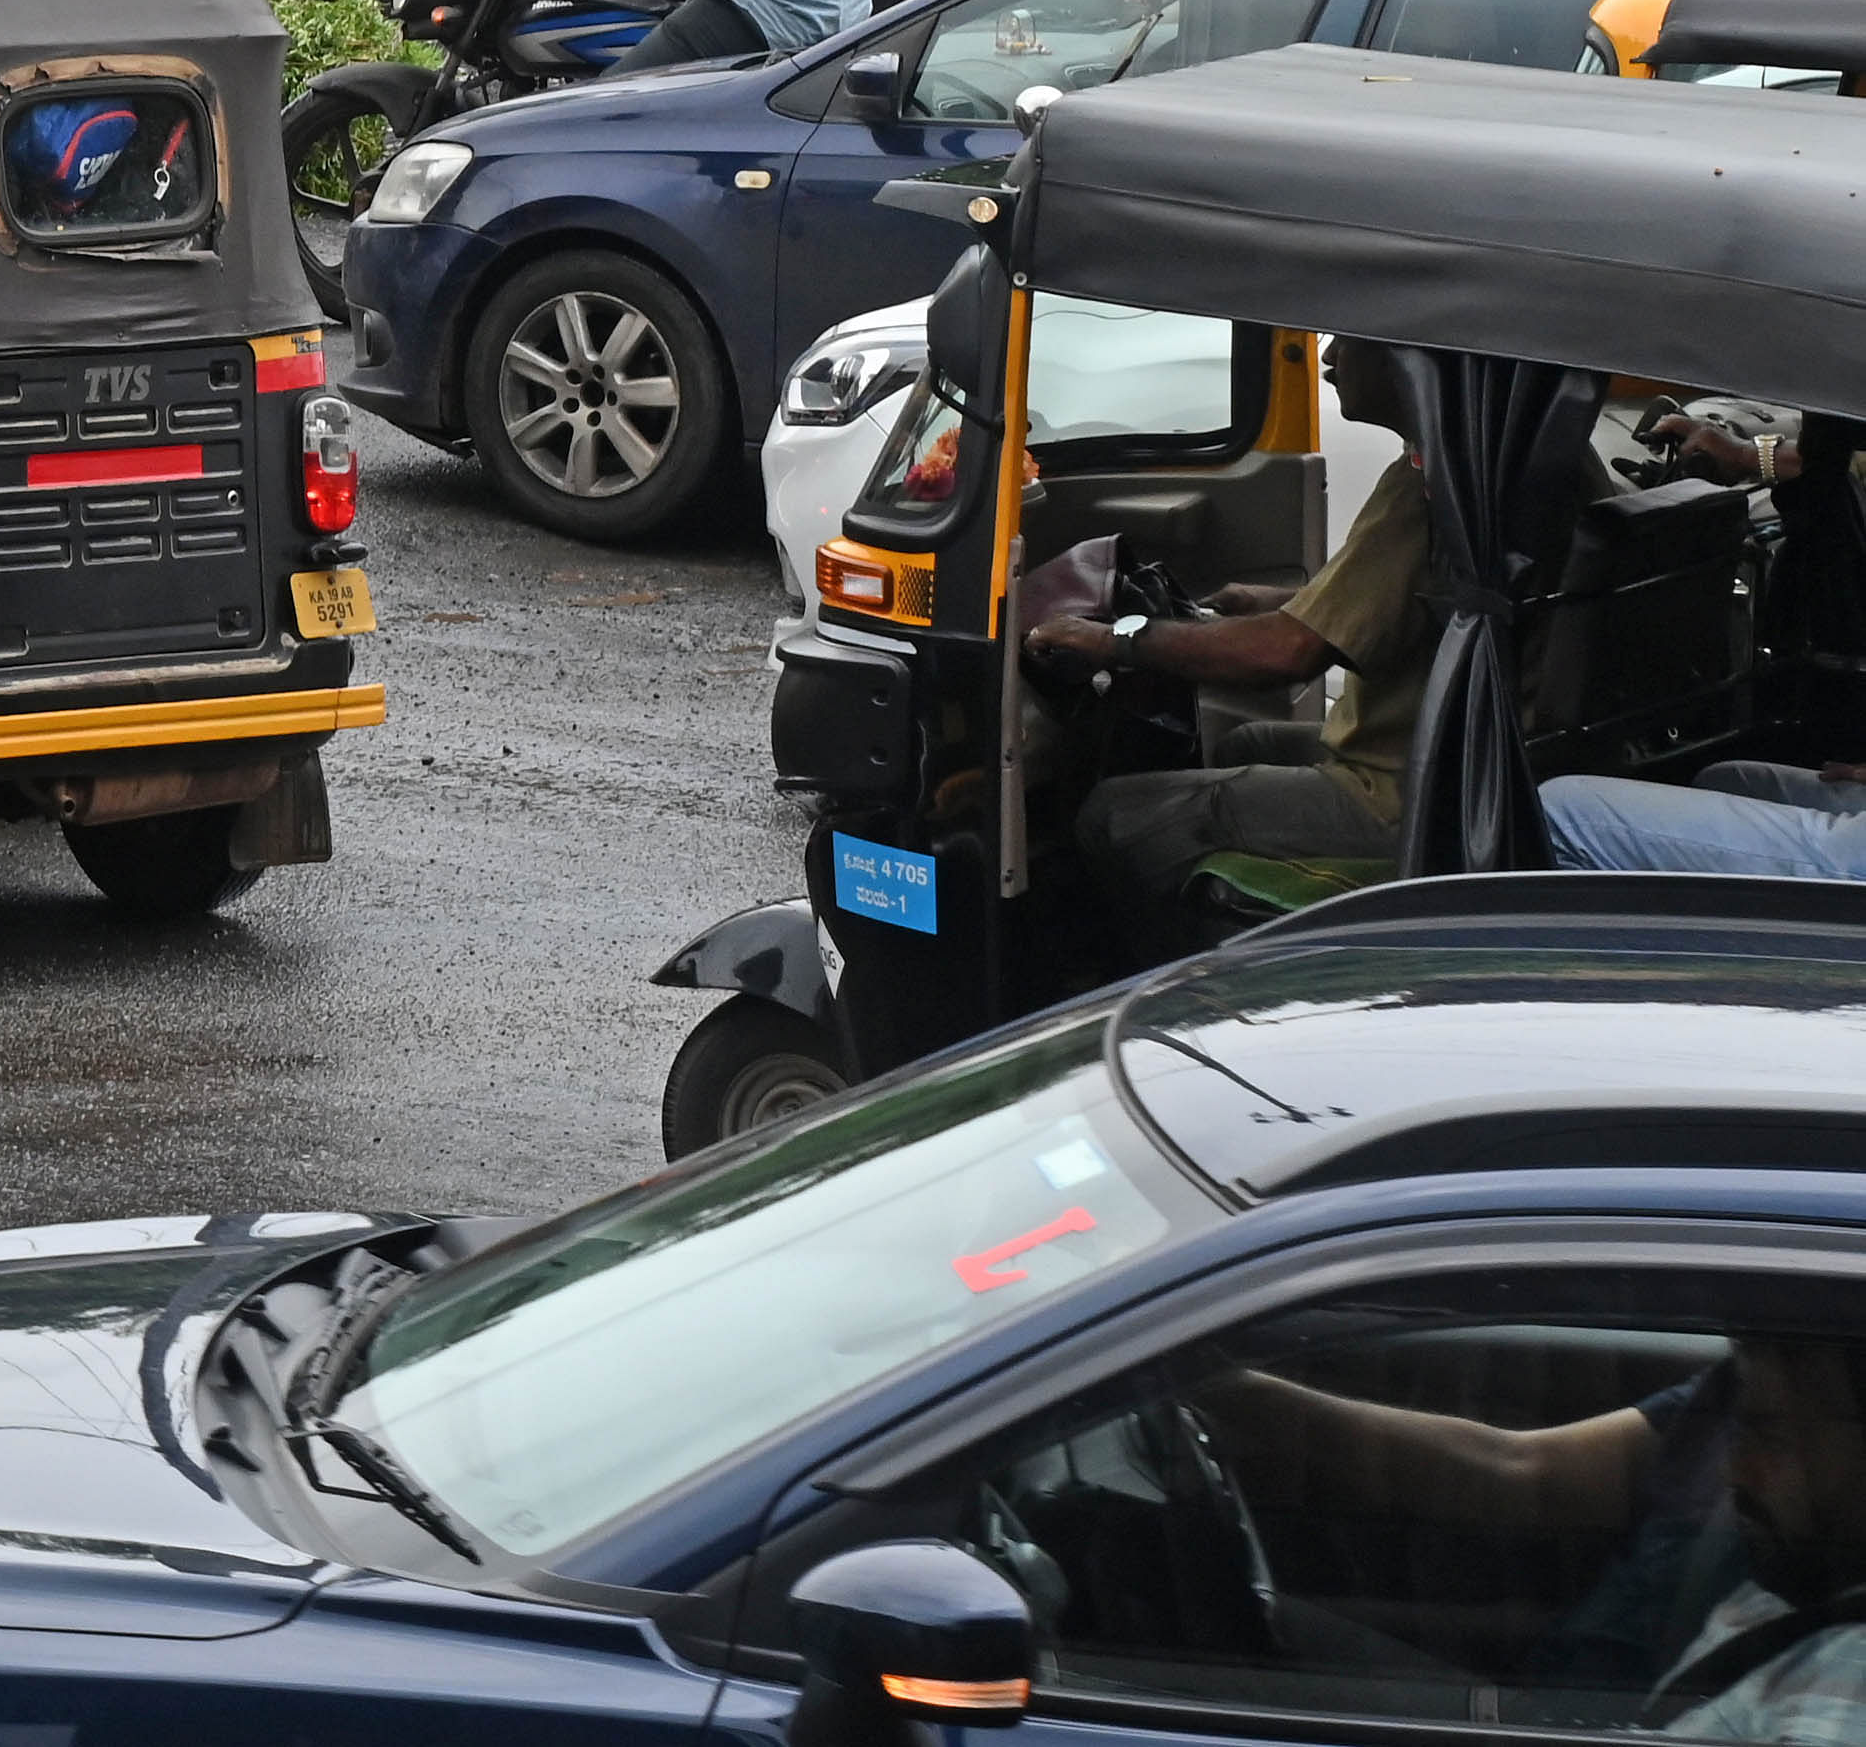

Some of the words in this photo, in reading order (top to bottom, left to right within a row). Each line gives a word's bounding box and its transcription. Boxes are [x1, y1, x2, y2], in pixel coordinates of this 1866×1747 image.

[84, 364, 151, 403] TVS
[316, 602, 355, 622] 5291
[881, 859, 928, 886] 4705
